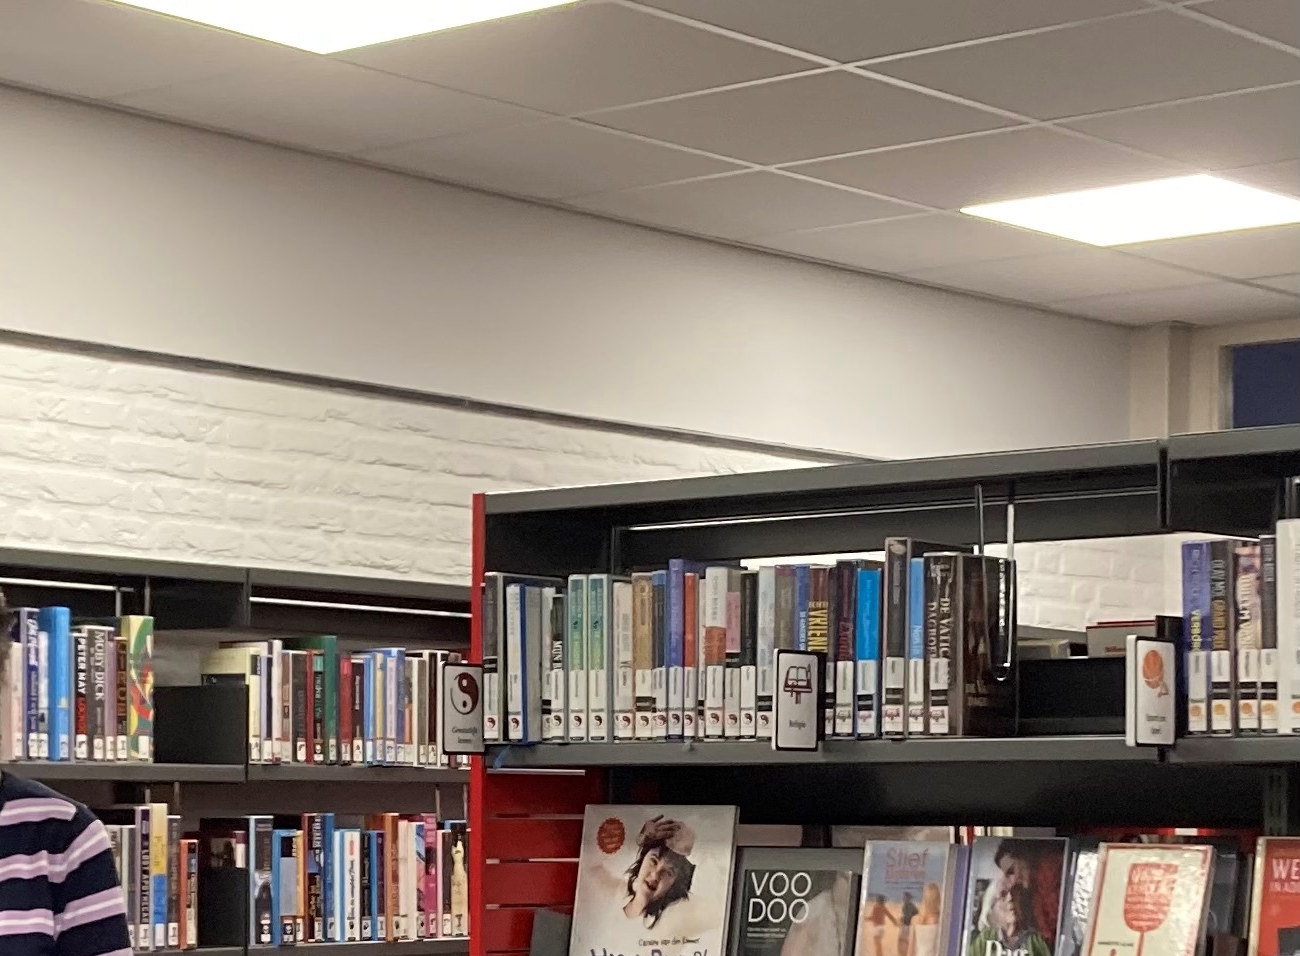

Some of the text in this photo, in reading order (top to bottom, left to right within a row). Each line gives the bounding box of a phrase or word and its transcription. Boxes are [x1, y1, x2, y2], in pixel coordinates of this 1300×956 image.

[1211, 560, 1226, 580] OLAV
[940, 597, 951, 614] DE
[78, 638, 87, 670] PETER
[78, 672, 87, 695] MAY
[750, 871, 813, 897] VOO
[141, 873, 150, 923] APOTHECAR
[748, 897, 810, 923] DOO
